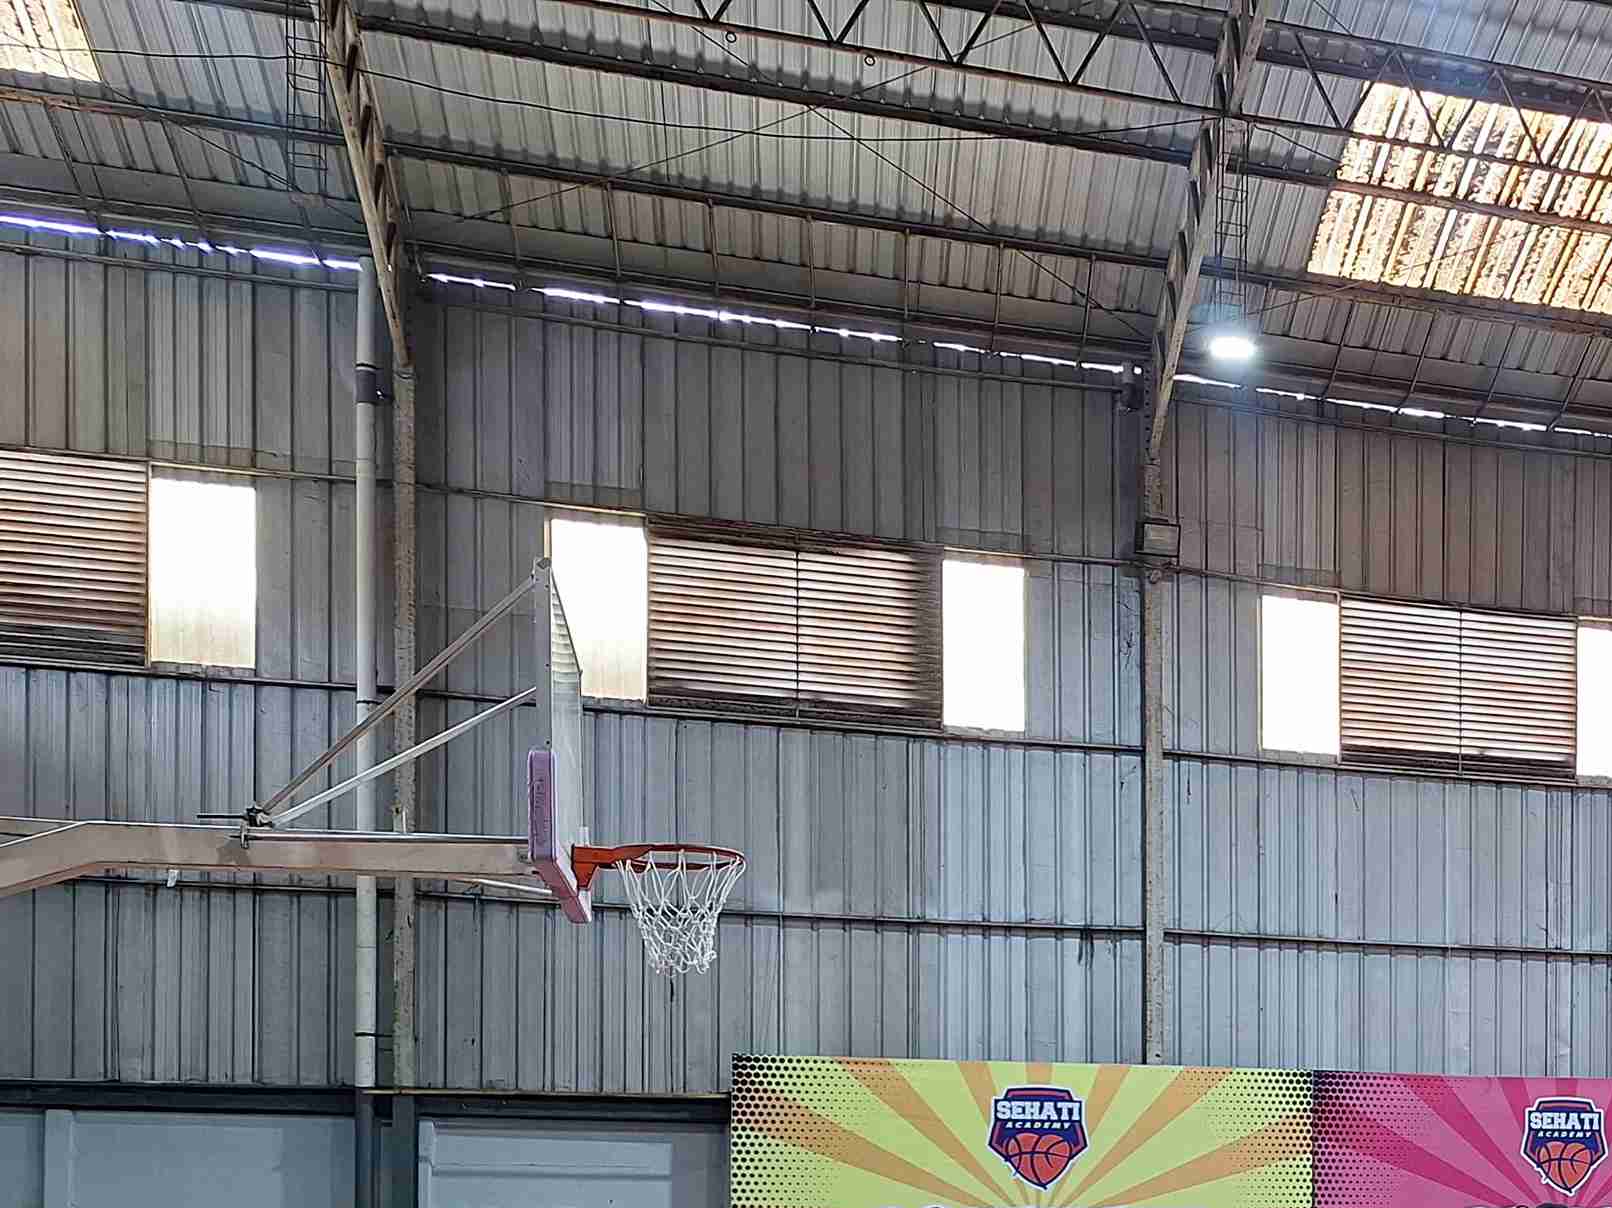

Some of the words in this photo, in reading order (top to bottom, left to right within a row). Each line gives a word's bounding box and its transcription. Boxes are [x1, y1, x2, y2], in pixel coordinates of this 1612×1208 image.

[996, 1100, 1080, 1120] SEHATI
[1005, 1121, 1072, 1129] ACADEMY
[1530, 1112, 1600, 1130] SEHATI
